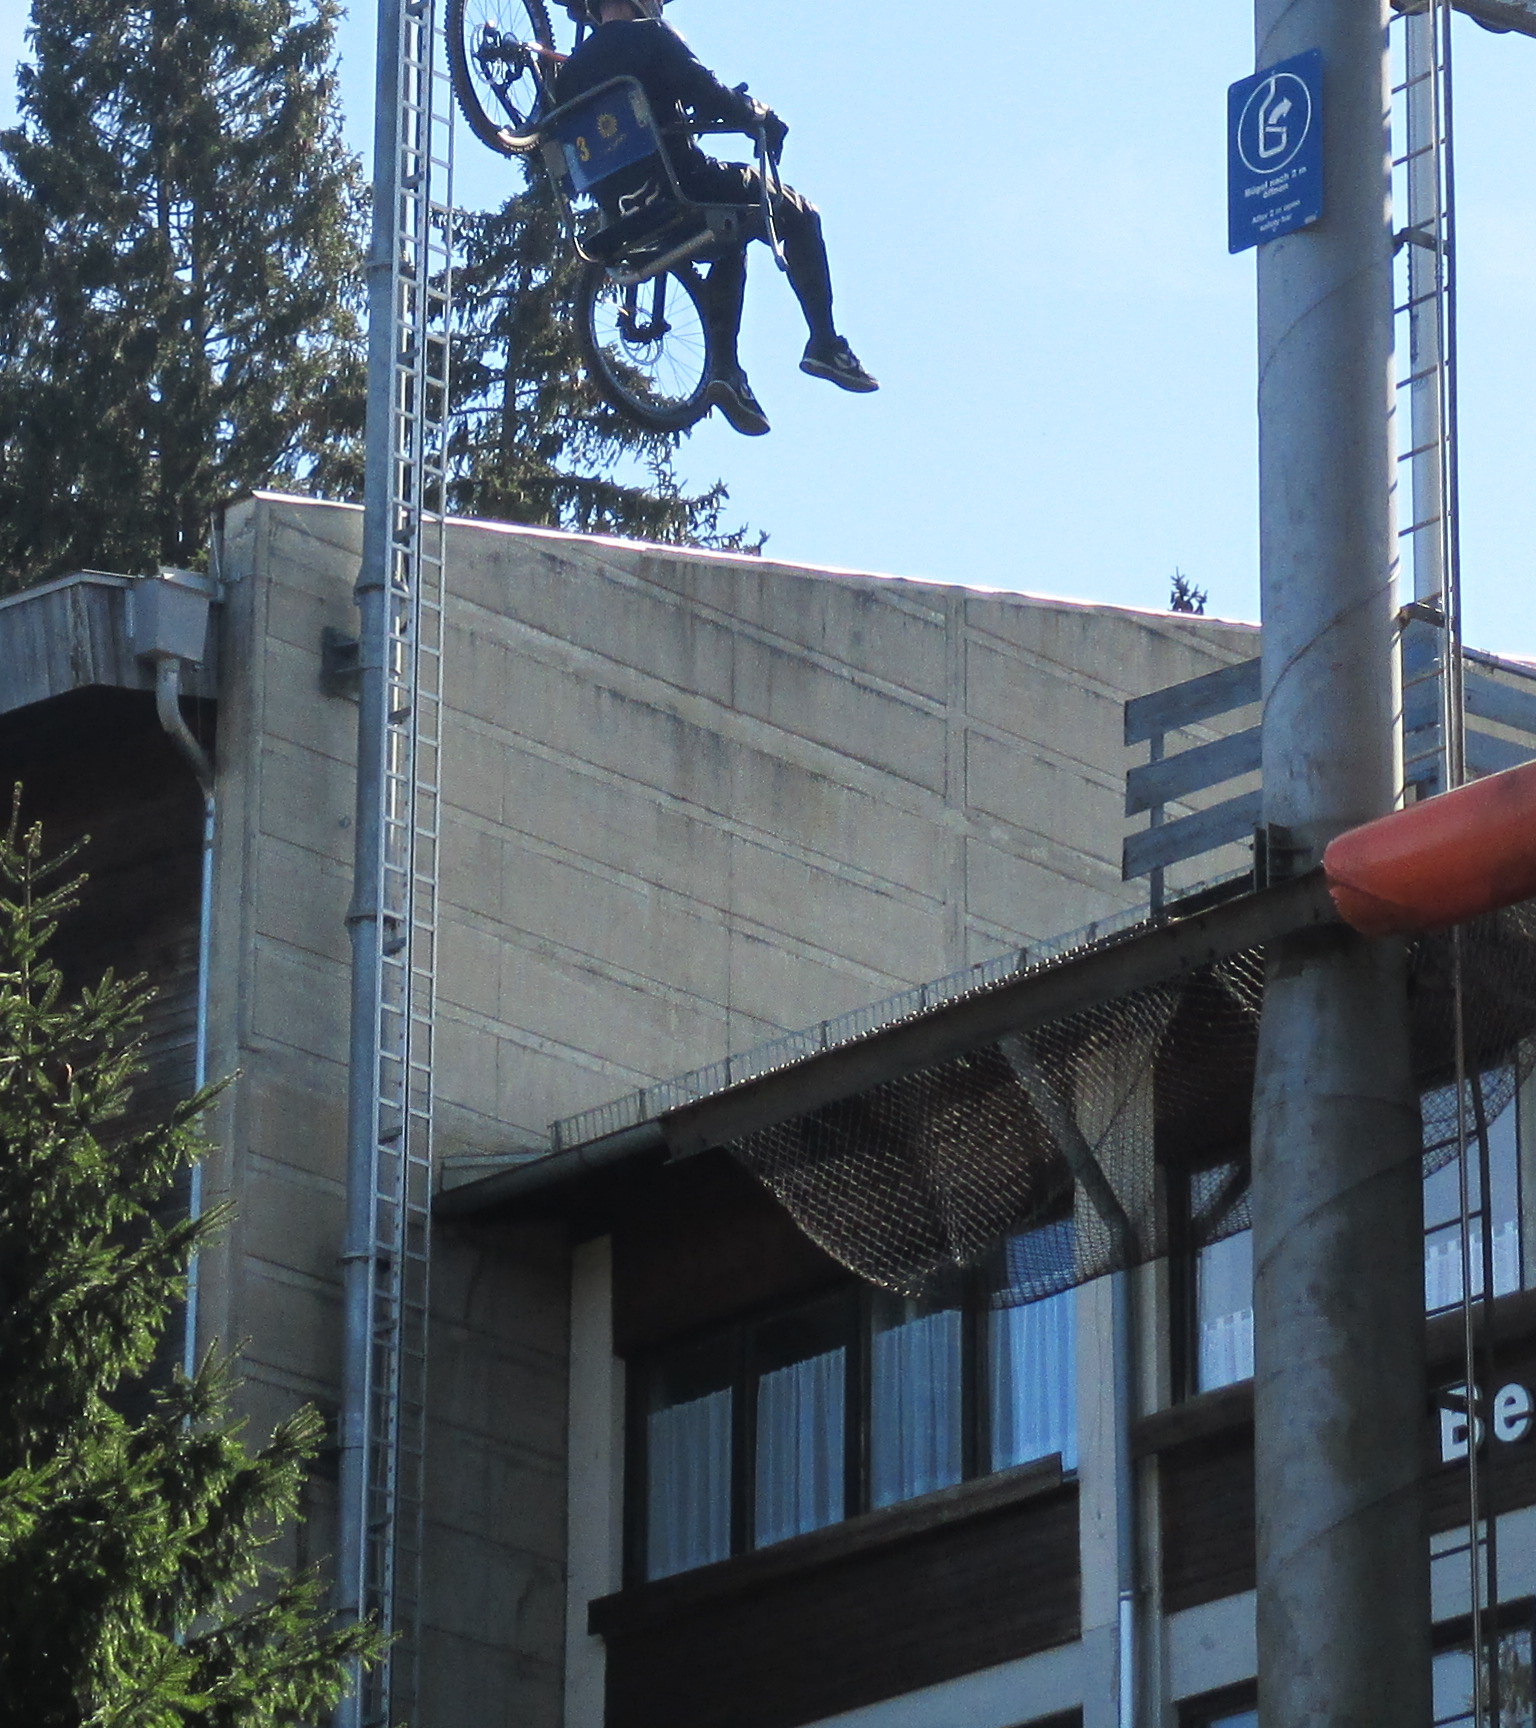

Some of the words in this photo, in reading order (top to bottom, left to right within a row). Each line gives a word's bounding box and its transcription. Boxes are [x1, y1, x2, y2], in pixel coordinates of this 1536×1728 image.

[576, 135, 591, 162] 3
[1269, 172, 1290, 187] nach
[1291, 169, 1297, 178] 2
